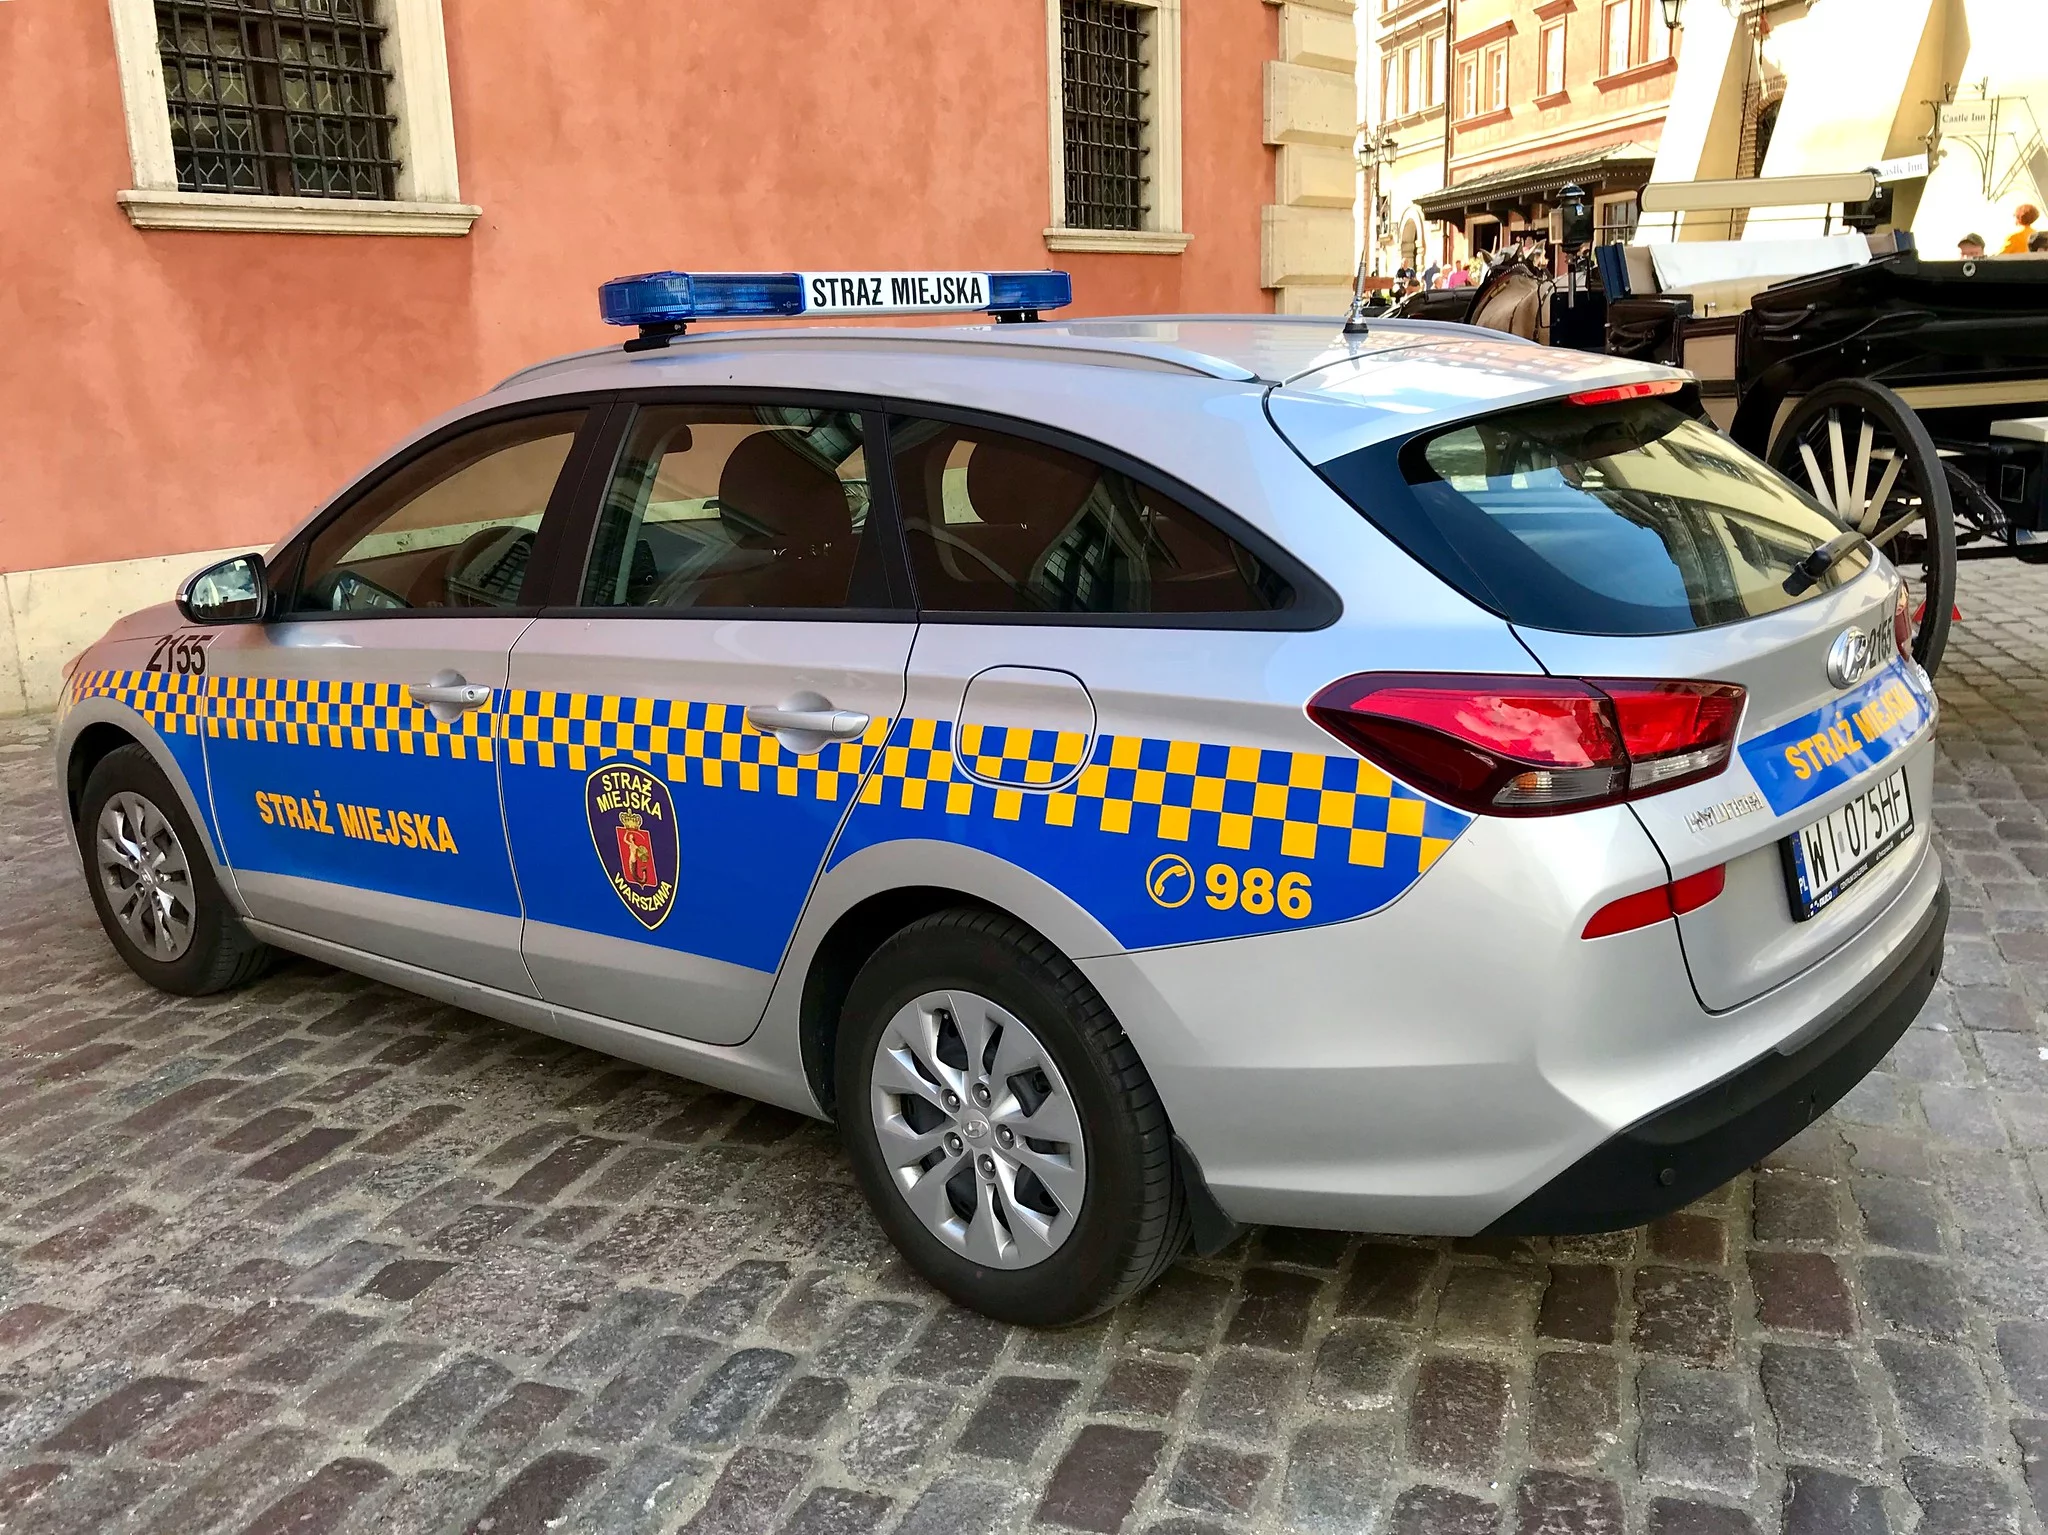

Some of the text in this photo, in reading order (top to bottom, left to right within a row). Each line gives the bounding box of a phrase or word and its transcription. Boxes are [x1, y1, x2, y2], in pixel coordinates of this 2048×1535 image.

[1942, 113, 1986, 123] Castle Inn
[1883, 161, 1923, 177] astle Inn
[891, 276, 983, 305] MIEJSKA
[145, 634, 213, 675] 2155
[1785, 680, 1917, 780] STRAŻ MIEJSKA
[255, 789, 459, 854] STRAŻ MIEJSKA
[596, 790, 663, 821] MIEJSKA
[614, 871, 673, 912] WARSZAWA
[1205, 863, 1313, 920] 986
[1799, 876, 1808, 895] PL
